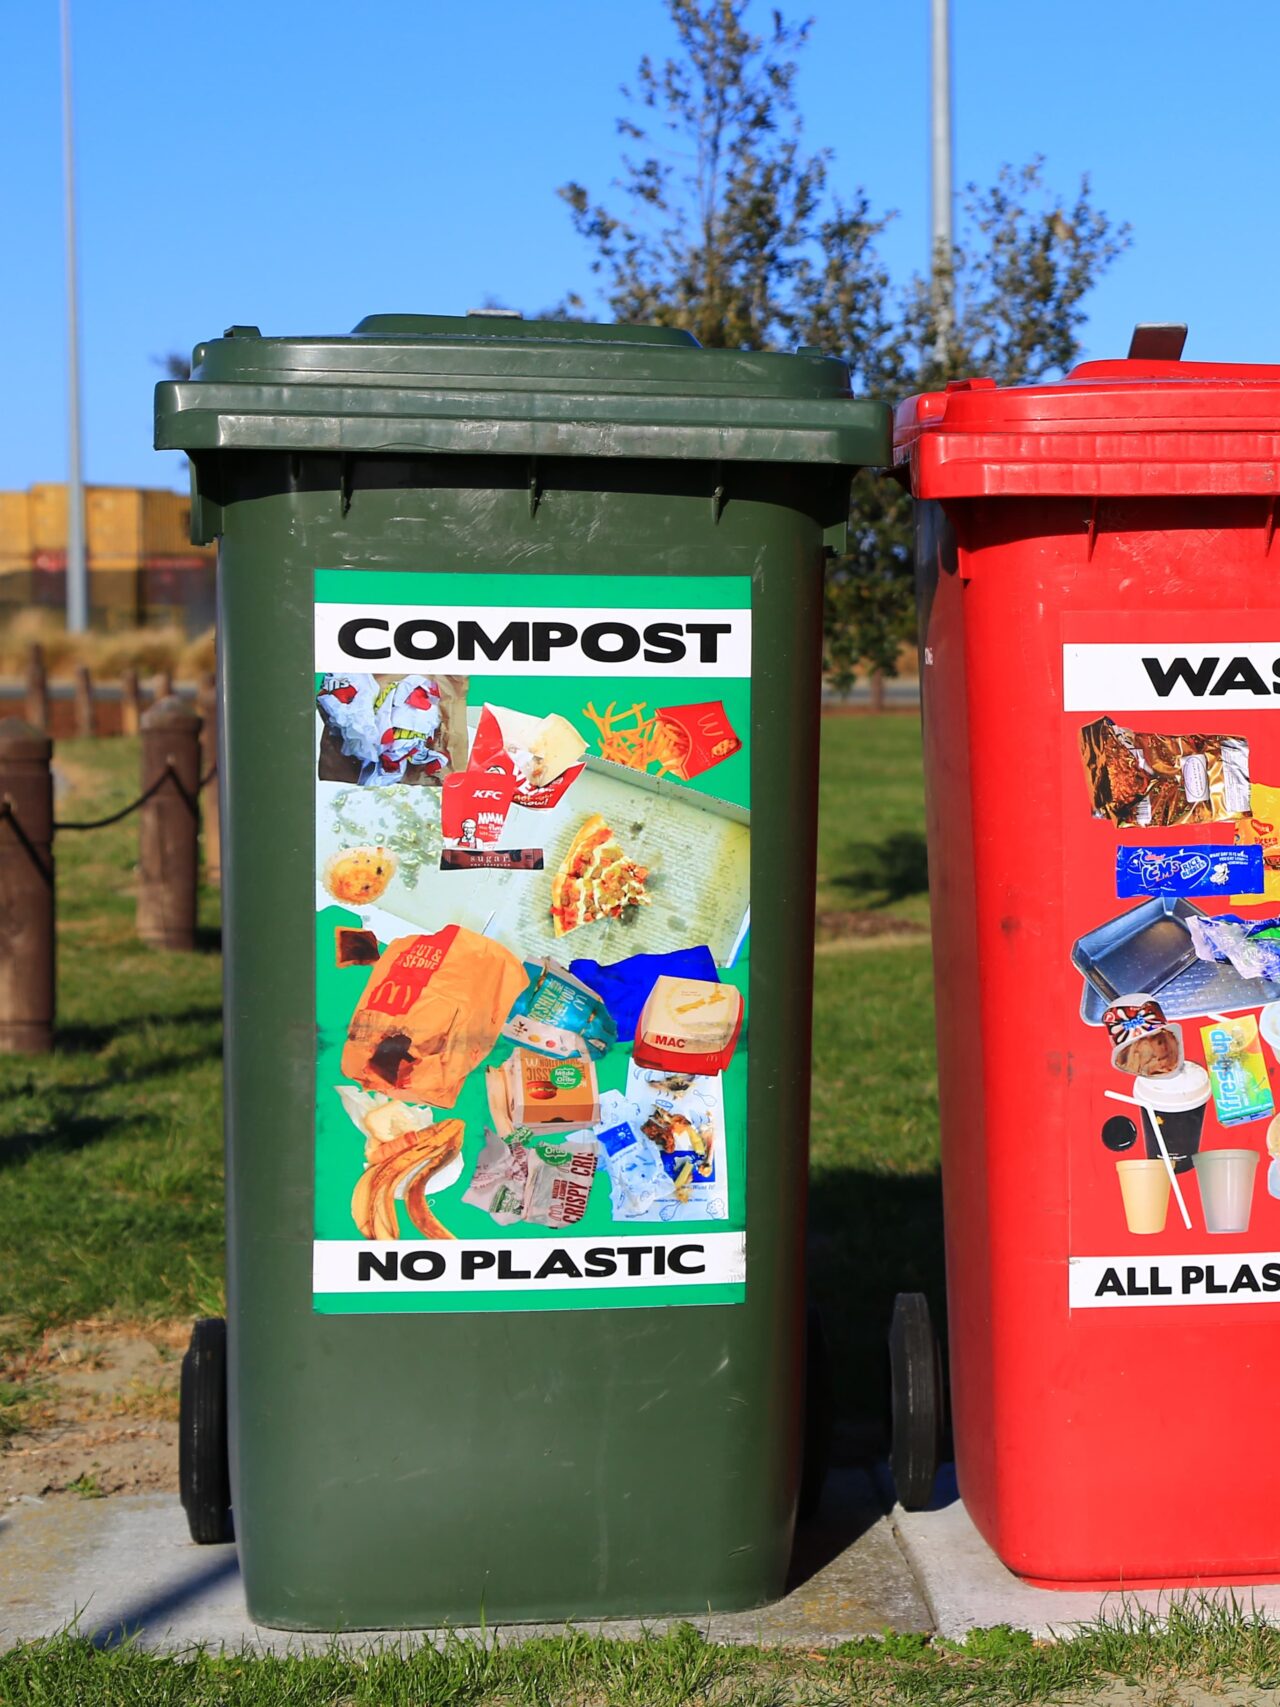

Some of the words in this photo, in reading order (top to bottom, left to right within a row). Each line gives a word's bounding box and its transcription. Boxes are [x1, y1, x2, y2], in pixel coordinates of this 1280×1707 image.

[337, 617, 732, 663] COMPOST
[472, 790, 504, 801] KFC
[470, 854, 507, 865] sugar
[431, 948, 442, 962] &
[655, 1034, 686, 1049] MAC
[1209, 1029, 1232, 1055] up
[1212, 1056, 1241, 1114] fresh
[562, 1181, 589, 1224] CRISPY
[357, 1249, 446, 1281] NO
[461, 1244, 706, 1281] PLASTIC
[1094, 1267, 1171, 1297] ALL
